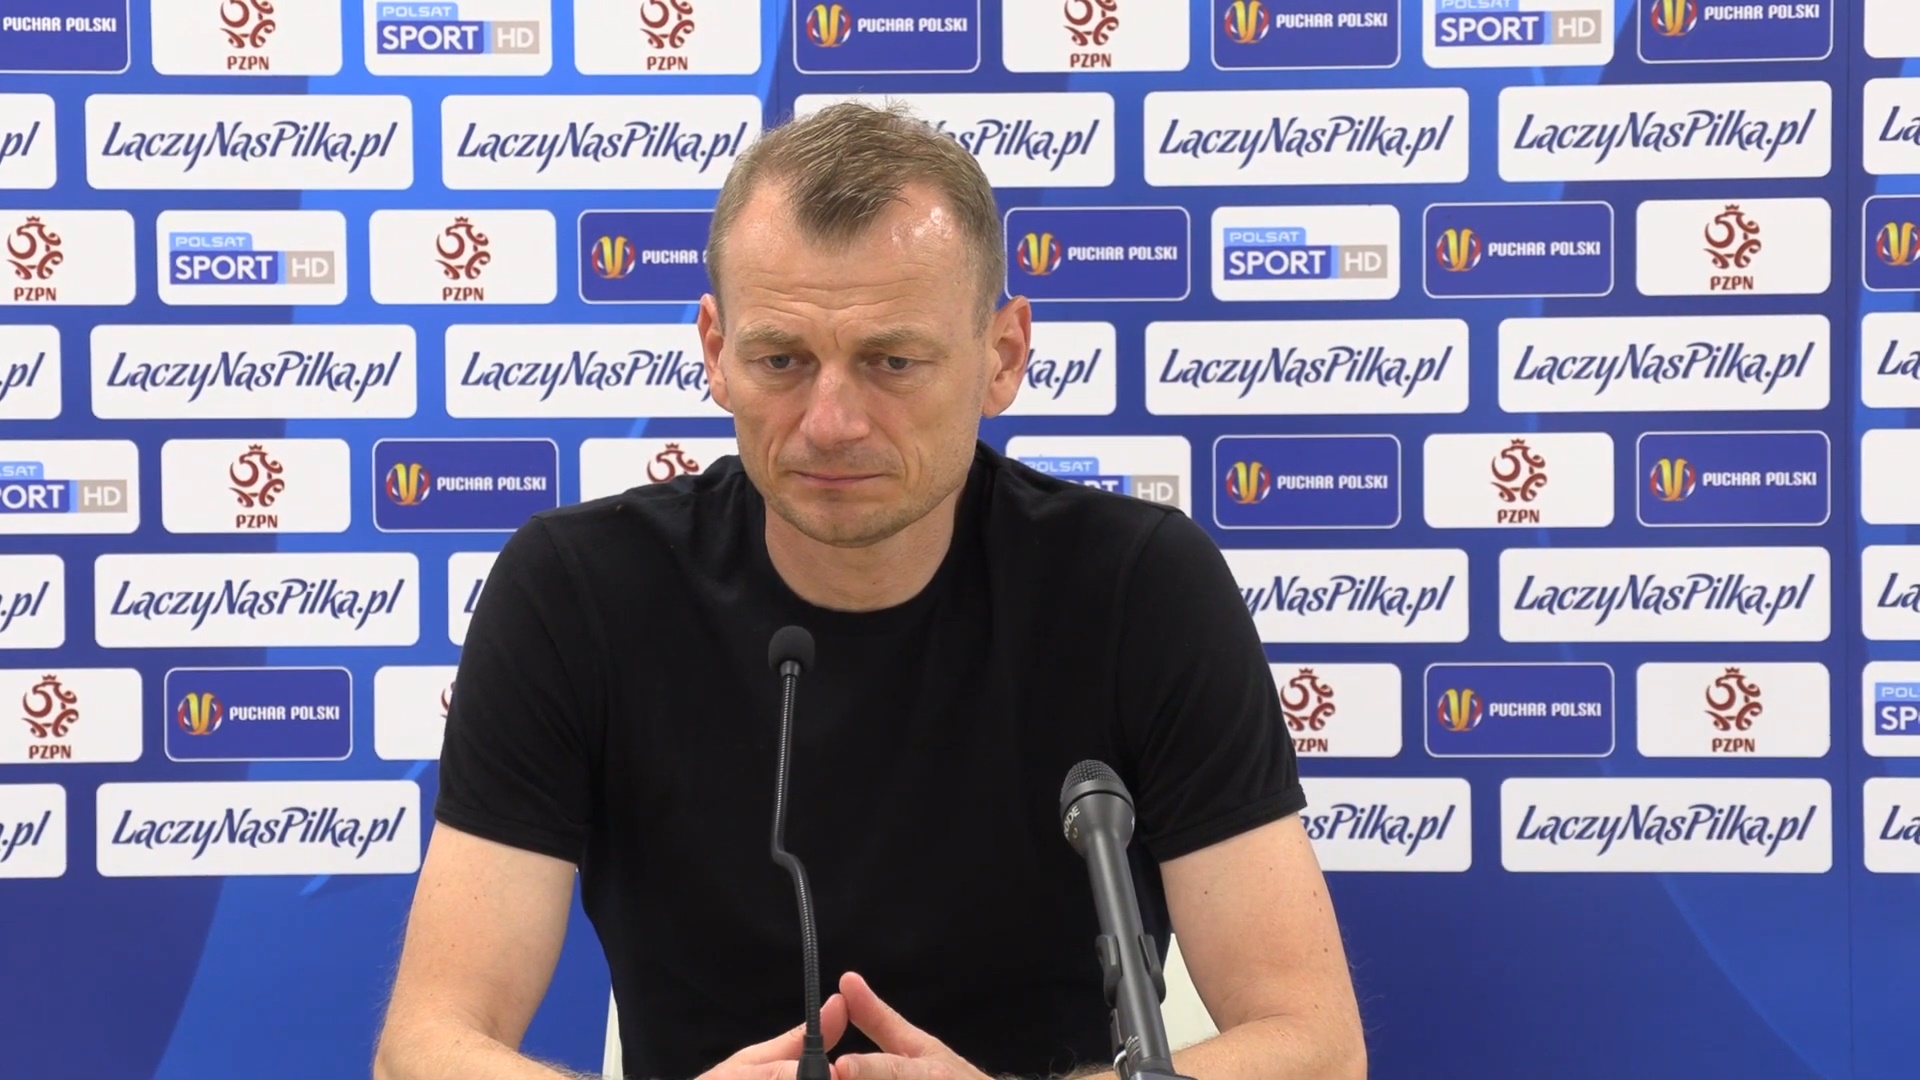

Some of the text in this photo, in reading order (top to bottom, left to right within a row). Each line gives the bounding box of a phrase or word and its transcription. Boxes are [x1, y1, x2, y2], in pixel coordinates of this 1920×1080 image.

[383, 6, 451, 17] POLSAT
[1705, 4, 1819, 20] PUCHAR POLSKI
[3, 17, 116, 32] PUCHAR POLSKI
[858, 18, 967, 32] PUCHAR POLSKI
[1277, 13, 1387, 28] PUCHAR POLSKI
[1441, 16, 1595, 42] SPORT HD
[383, 25, 533, 50] SPORT HD
[228, 56, 269, 70] PZPN
[647, 56, 687, 70] PZPN
[1071, 53, 1111, 67] PZPN
[1160, 116, 1453, 168] LaczyNasPilka.pl
[1515, 109, 1816, 163] LaczyNasPilka.pl
[103, 121, 397, 172] LaczyNasPilka.pl
[458, 121, 748, 173] LaczyNasPilka.pl
[923, 119, 1100, 172] sPilka.pl
[176, 237, 245, 247] POLSAT
[1230, 232, 1299, 242] POLSAT
[1068, 247, 1177, 260] PUCHAR POLSKI
[1489, 241, 1600, 256] PUCHAR POLSKI
[643, 250, 698, 263] PUCHAR
[1230, 250, 1381, 275] SPORT HD
[176, 256, 328, 280] SPORT HD
[1711, 276, 1753, 290] PZPN
[14, 287, 56, 301] PZPN
[443, 287, 483, 300] PZPN
[1160, 346, 1452, 398] LaczyNasPilka.pl
[1514, 342, 1814, 394] LaczyNasPilka.pl
[107, 351, 401, 402] LaczyNasPilka.pl
[461, 350, 711, 402] LaczyNasPilka.
[437, 477, 546, 490] PUCHAR POLSKI
[1278, 475, 1387, 489] PUCHAR POLSKI
[1703, 472, 1816, 486] PUCHAR POLSKI
[84, 487, 121, 505] HD
[1138, 482, 1173, 501] HD
[236, 515, 277, 528] PZPN
[1498, 509, 1539, 523] PZPN
[111, 579, 404, 629] LaczyNasPilka.pl
[1240, 575, 1455, 627] yNasPilka.pl
[1515, 574, 1814, 625] LaczyNasPilka.pl
[230, 706, 339, 720] PUCHAR POLSKI
[1490, 703, 1601, 716] PUCHAR POLSKI
[29, 745, 71, 759] PZPN
[1712, 738, 1754, 752] PZPN
[112, 807, 405, 859] LaczyNasPilka.pl
[1517, 804, 1816, 856] LaczyNasPilka.pl
